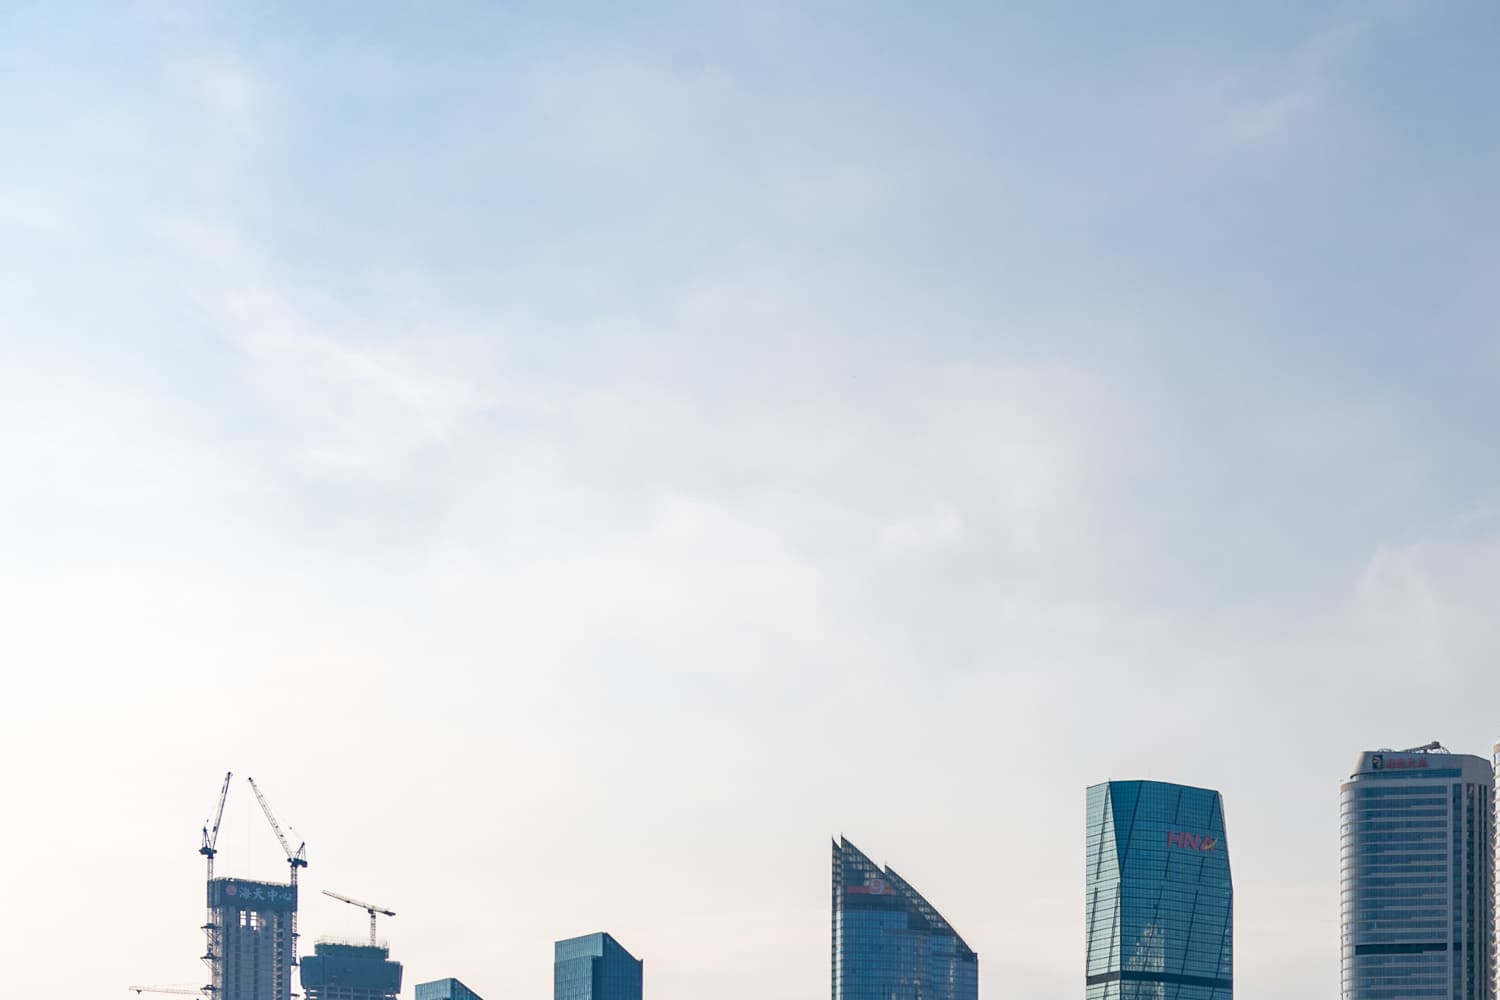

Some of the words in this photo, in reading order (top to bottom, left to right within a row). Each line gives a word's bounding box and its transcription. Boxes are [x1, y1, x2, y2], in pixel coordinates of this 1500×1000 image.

[1168, 831, 1216, 852] HNA
[240, 886, 292, 902] 海天中心
